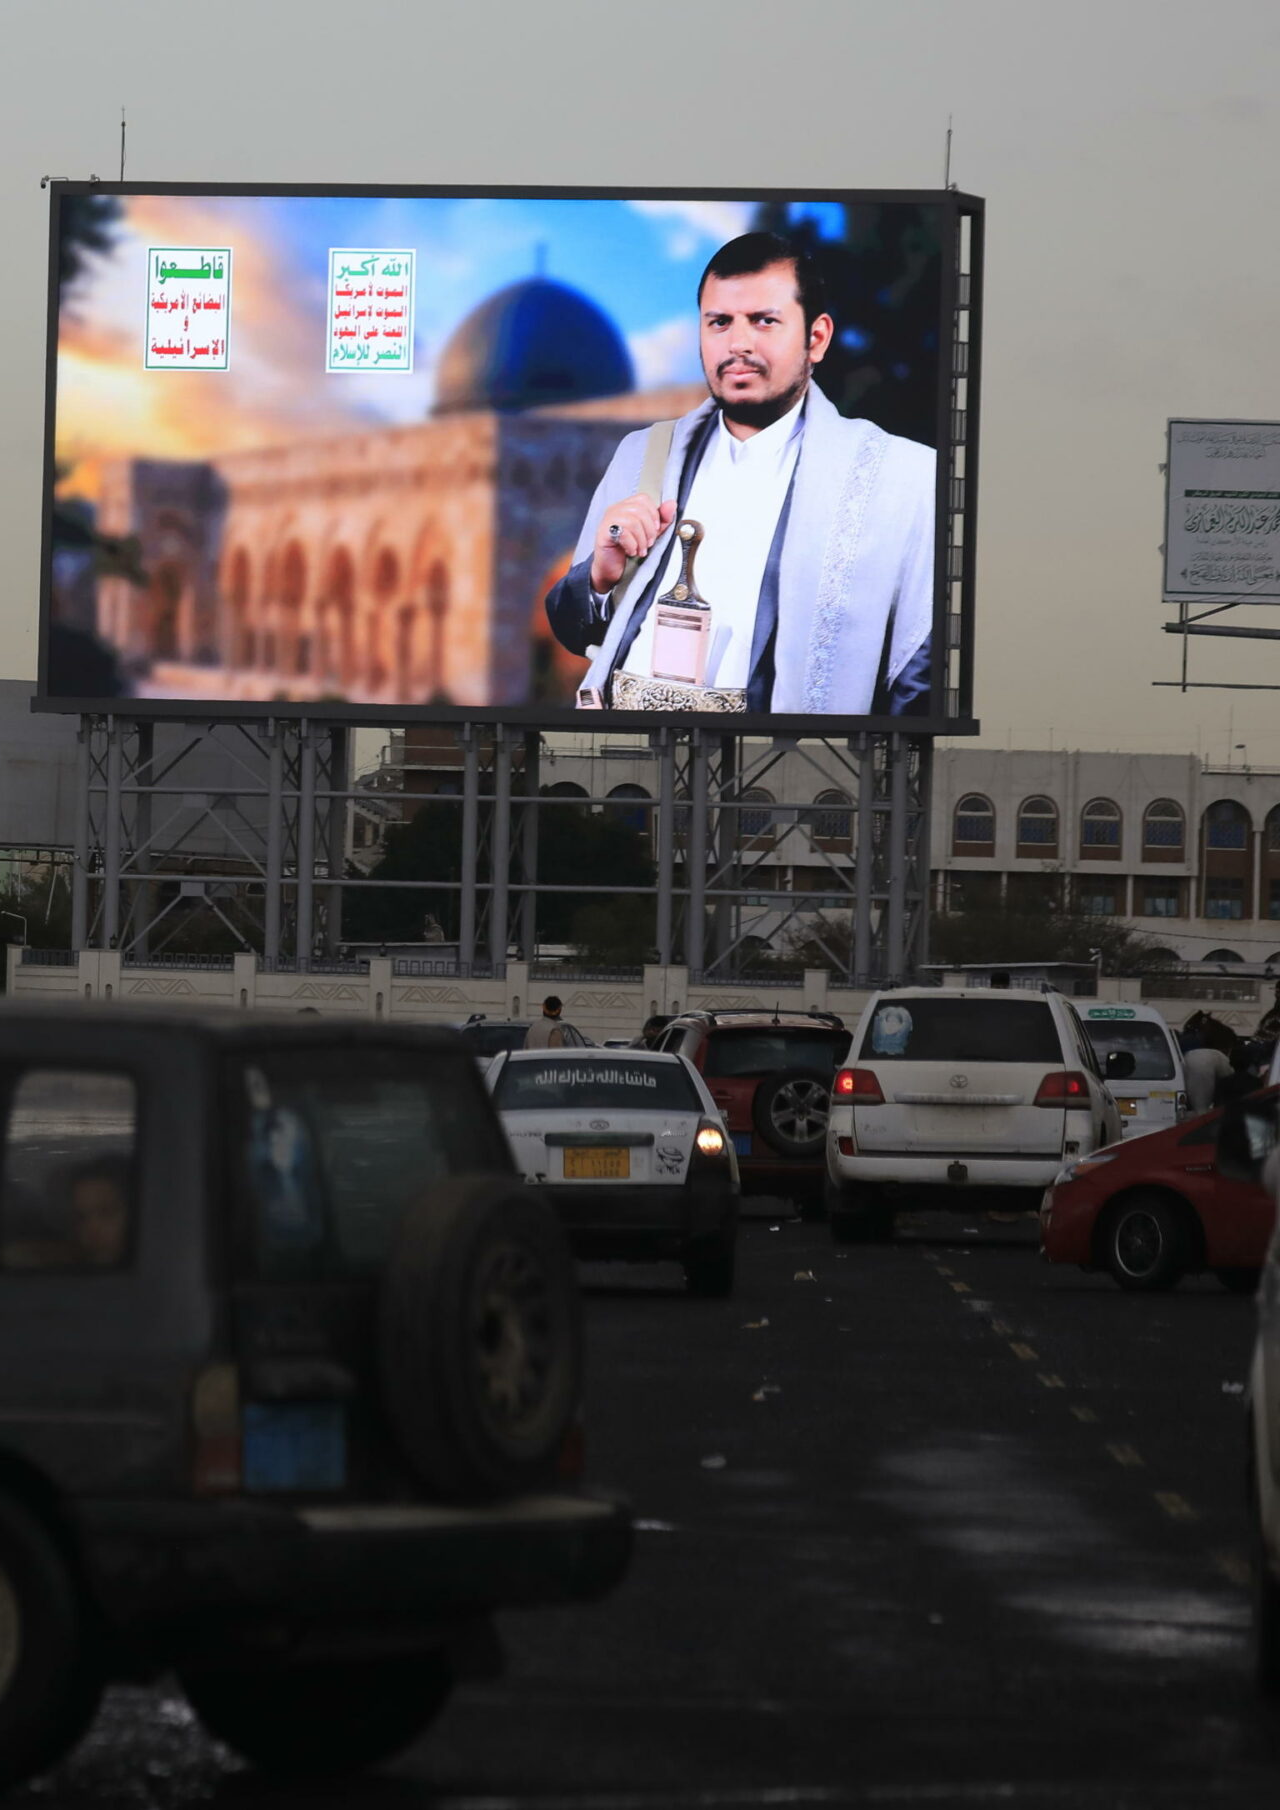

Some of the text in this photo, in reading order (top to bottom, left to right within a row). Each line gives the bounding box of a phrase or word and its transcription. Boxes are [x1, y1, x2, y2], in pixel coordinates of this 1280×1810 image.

[155, 255, 224, 285] قاطعوا
[335, 254, 409, 282] الله أكبر
[192, 291, 225, 314] البضائع
[376, 285, 408, 299] الموت
[376, 305, 407, 320] الموت
[373, 342, 407, 365] النصر
